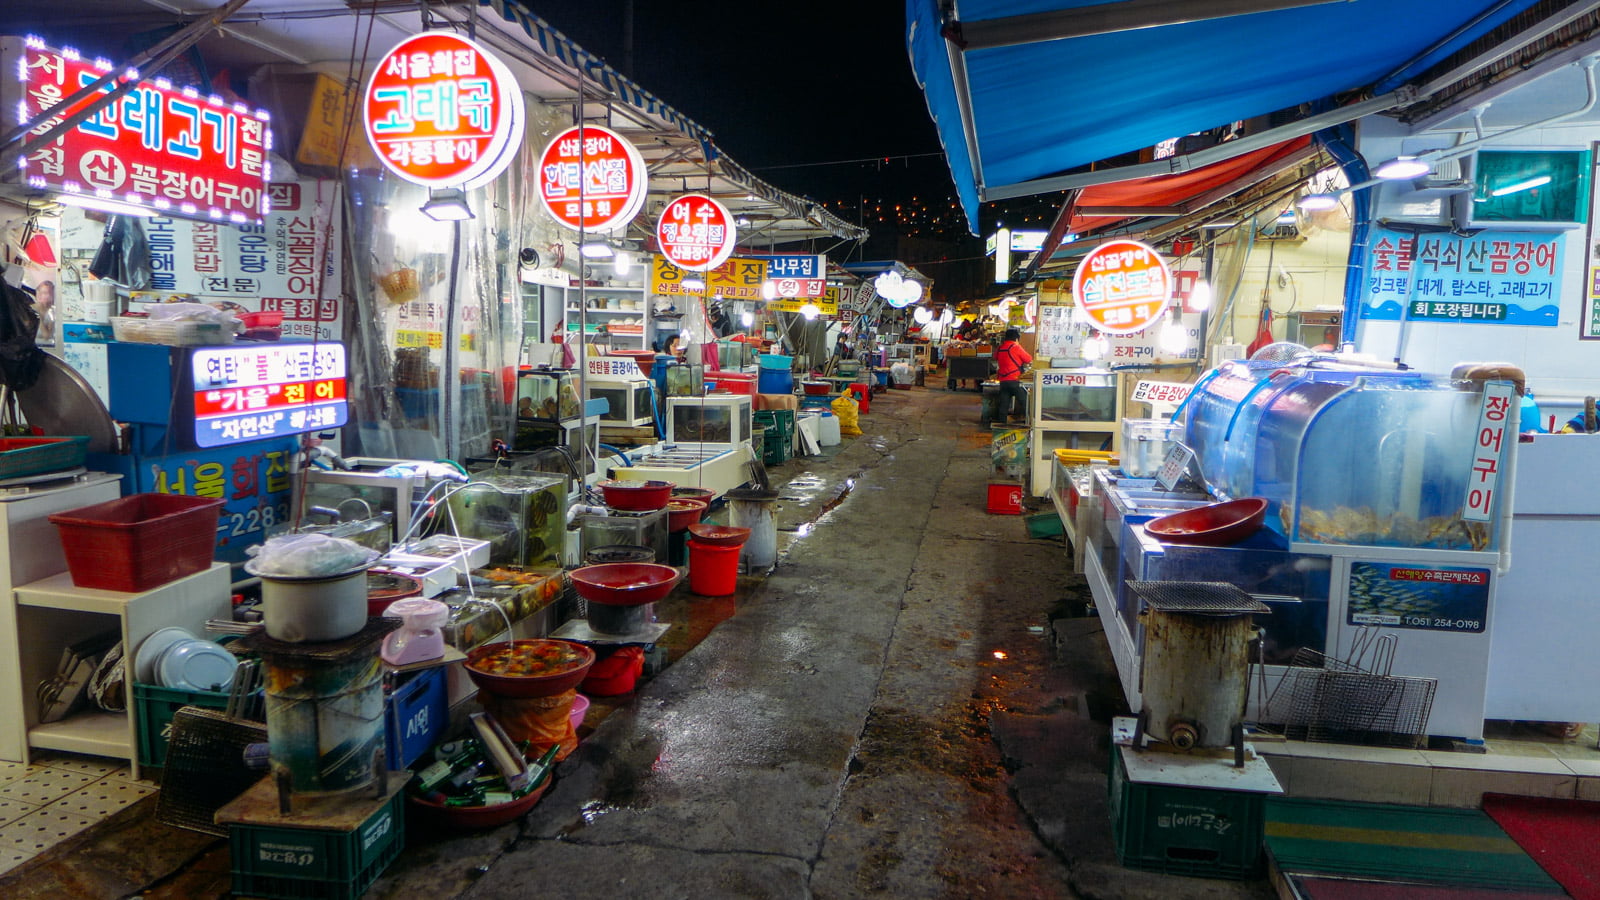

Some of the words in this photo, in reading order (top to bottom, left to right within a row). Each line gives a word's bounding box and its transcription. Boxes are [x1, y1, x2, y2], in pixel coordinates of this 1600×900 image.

[77, 70, 237, 169] 고래고기
[241, 117, 263, 177] 전문
[388, 138, 478, 166] 각종활어
[83, 152, 121, 189] 산
[130, 163, 262, 215] 꼼장어구이
[1498, 281, 1553, 299] 고래고기
[1415, 303, 1429, 316] 회
[1432, 303, 1502, 319] 포장됩니다
[1114, 346, 1154, 358] 조개구이
[207, 354, 239, 387] 연탄
[1042, 374, 1087, 385] 장어구이
[1468, 395, 1510, 515] 장어구이
[405, 704, 430, 740] 시원
